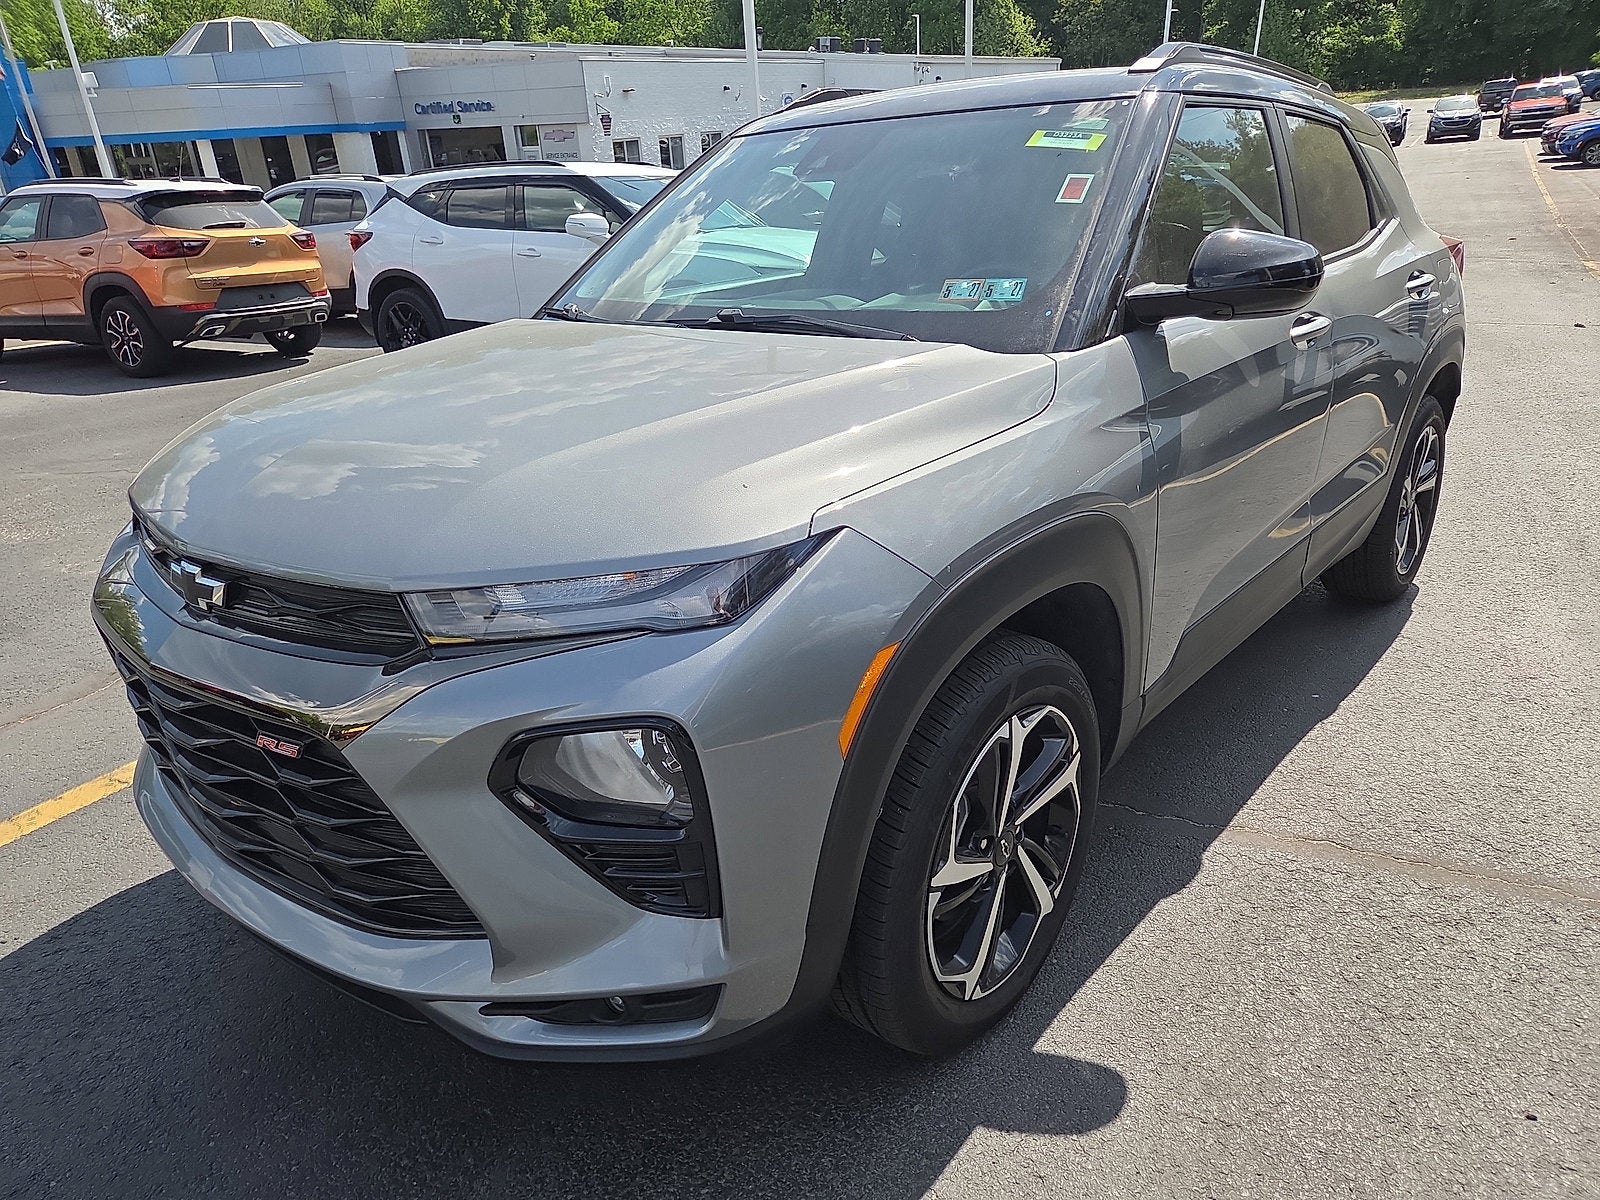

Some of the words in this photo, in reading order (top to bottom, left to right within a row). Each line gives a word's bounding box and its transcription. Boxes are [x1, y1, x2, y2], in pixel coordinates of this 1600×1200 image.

[414, 101, 454, 115] Certified
[456, 100, 492, 113] Service
[943, 285, 953, 298] 5
[968, 282, 981, 298] 27
[985, 284, 994, 298] 5
[1011, 281, 1024, 297] 27
[256, 734, 300, 758] RS
